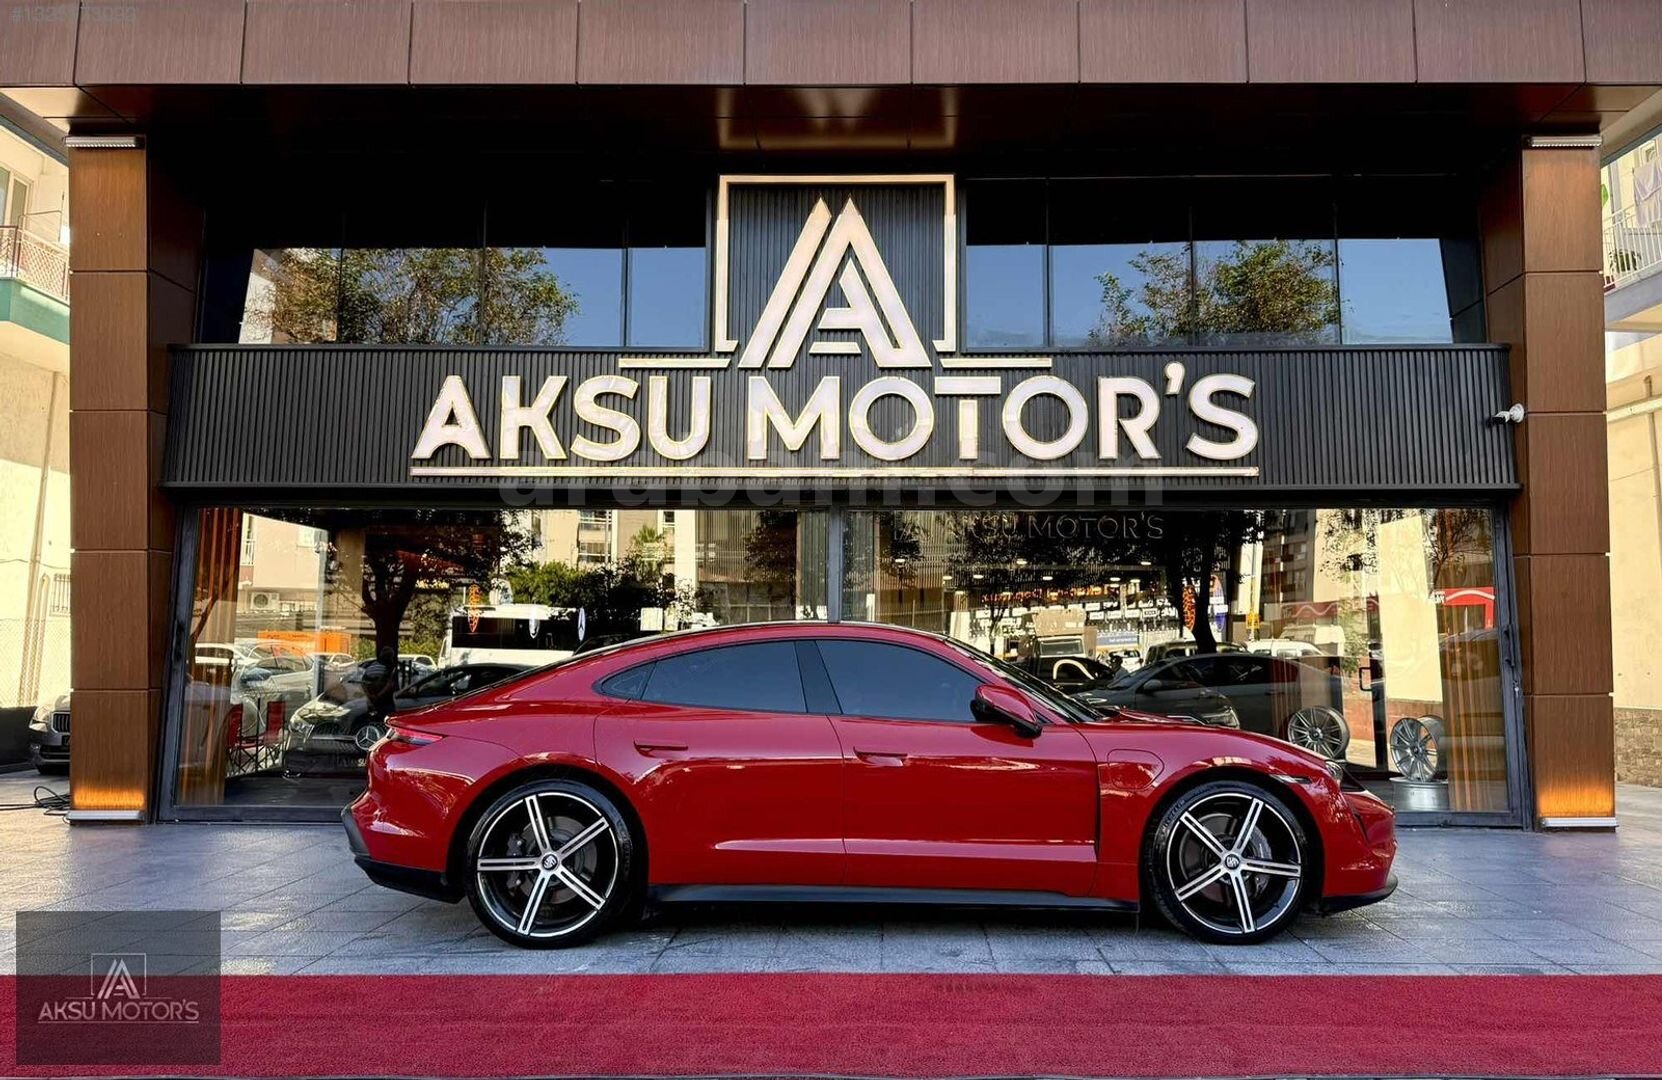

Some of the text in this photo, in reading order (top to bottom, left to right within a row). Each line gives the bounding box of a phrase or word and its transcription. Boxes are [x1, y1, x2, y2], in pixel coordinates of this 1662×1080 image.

[411, 361, 1260, 461] AKSU MOTOR'S
[1028, 511, 1165, 540] MOTOR'S
